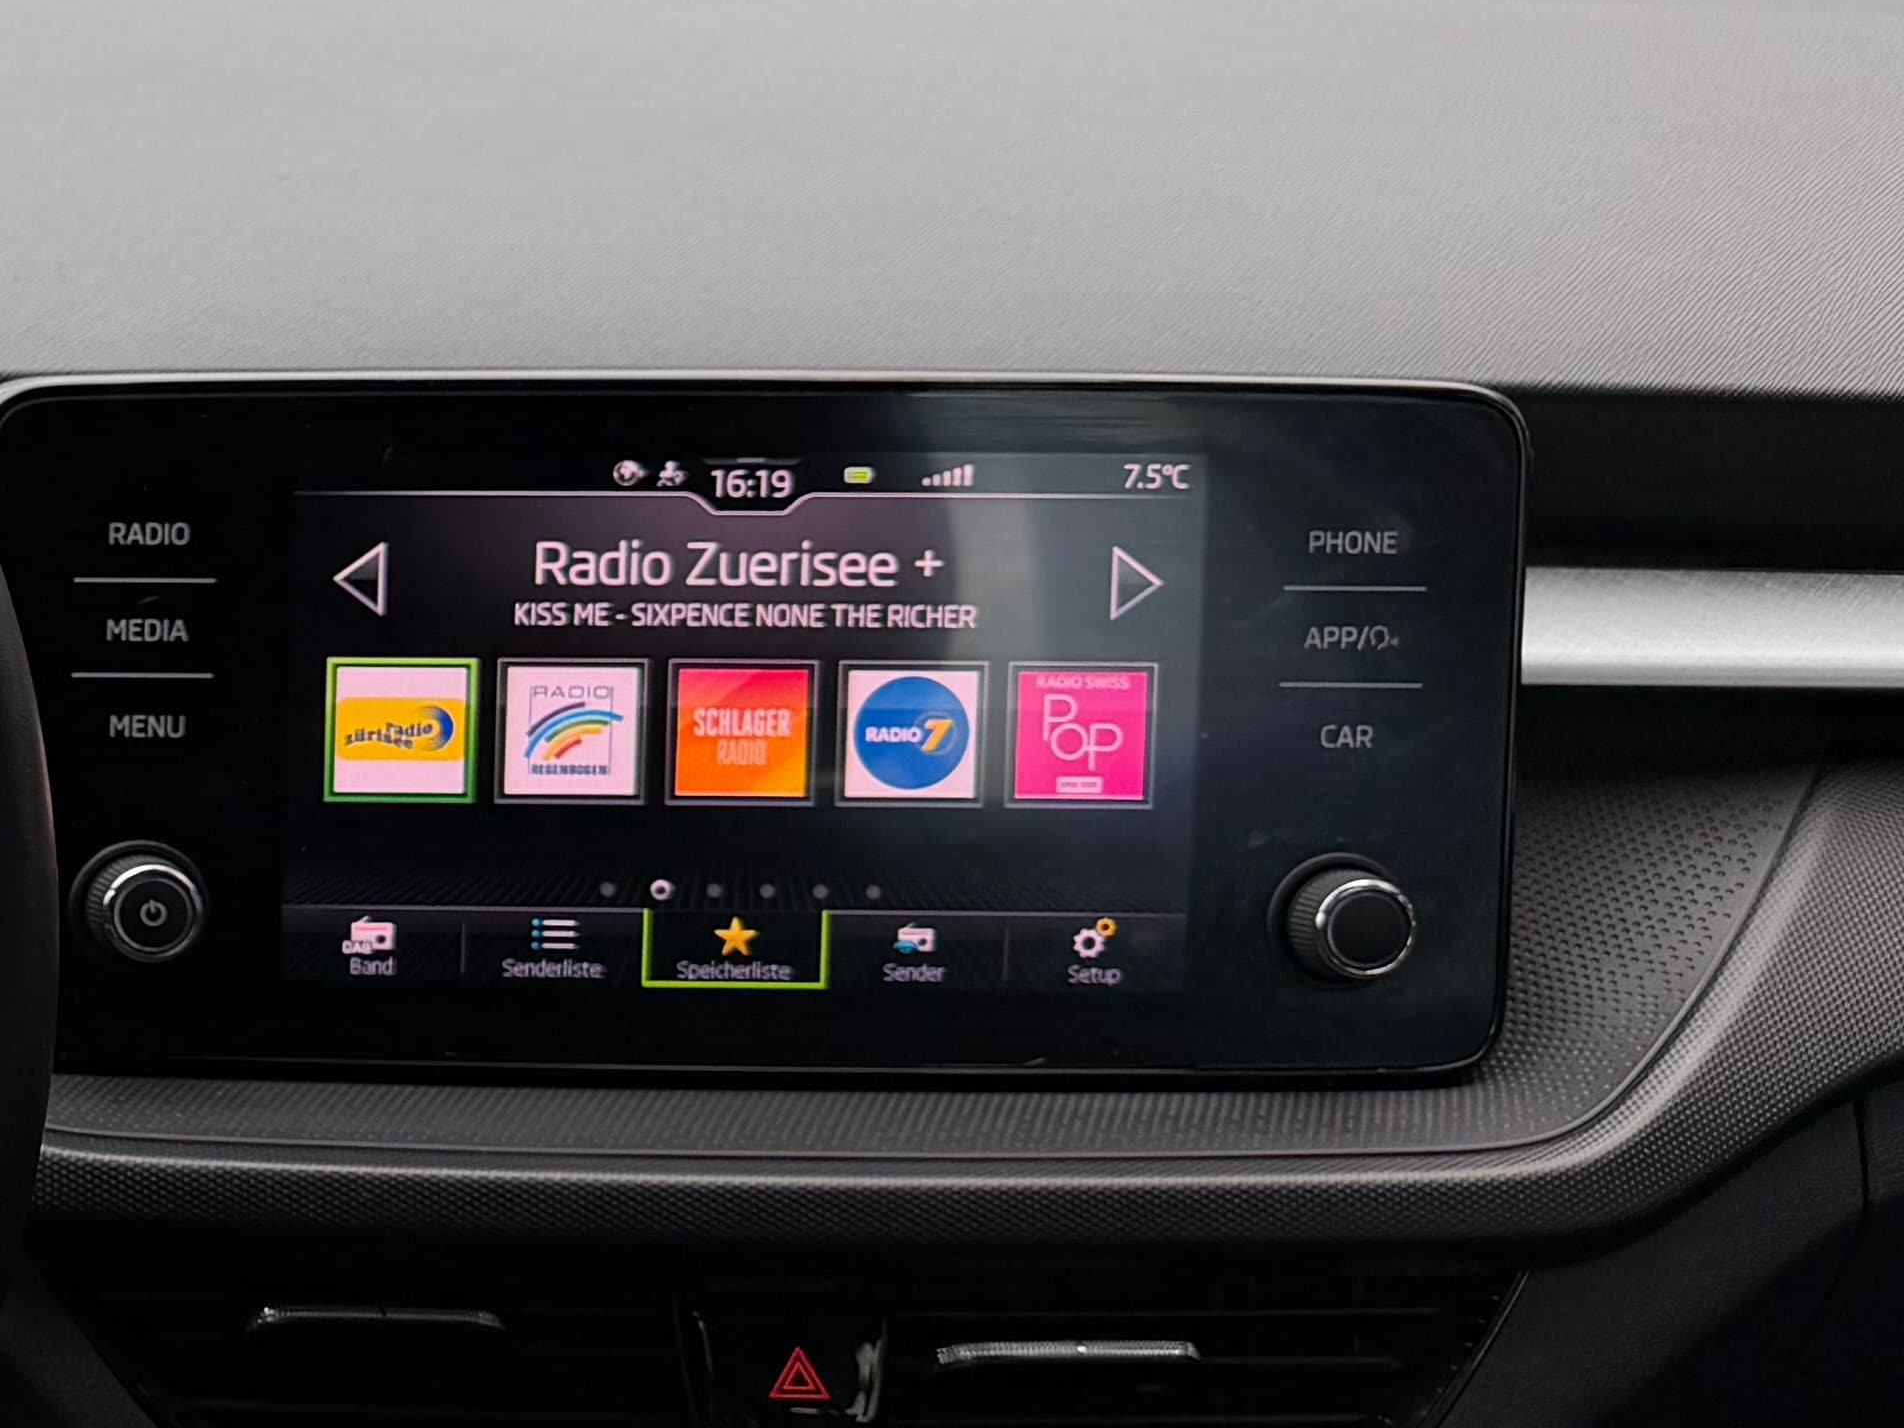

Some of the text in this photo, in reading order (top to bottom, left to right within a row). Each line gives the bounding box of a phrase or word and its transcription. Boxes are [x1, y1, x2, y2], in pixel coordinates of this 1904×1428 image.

[711, 469, 792, 499] 16:19
[108, 522, 191, 546] RADIO
[1308, 530, 1398, 555] PHONE
[534, 538, 673, 588] Radio
[685, 538, 900, 588] Zuerisee
[513, 602, 569, 628] KISS
[573, 602, 612, 628] ME
[631, 602, 751, 629] SIXPENCE
[756, 603, 826, 629] NONE
[831, 603, 883, 629] THE
[887, 604, 978, 630] RICHER
[106, 618, 189, 643] MEDIA
[532, 685, 610, 699] RADIO
[109, 714, 186, 739] MENU
[693, 708, 791, 738] SCHLAGER
[865, 718, 953, 753] RADIO 7
[1043, 693, 1124, 772] POP
[1320, 724, 1374, 749] CAR
[716, 740, 766, 766] RADIO
[349, 957, 395, 975] Band
[501, 958, 605, 978] Senderliste
[676, 960, 793, 982] Speicherliste
[882, 962, 946, 984] Sender
[1067, 964, 1122, 986] Setup
